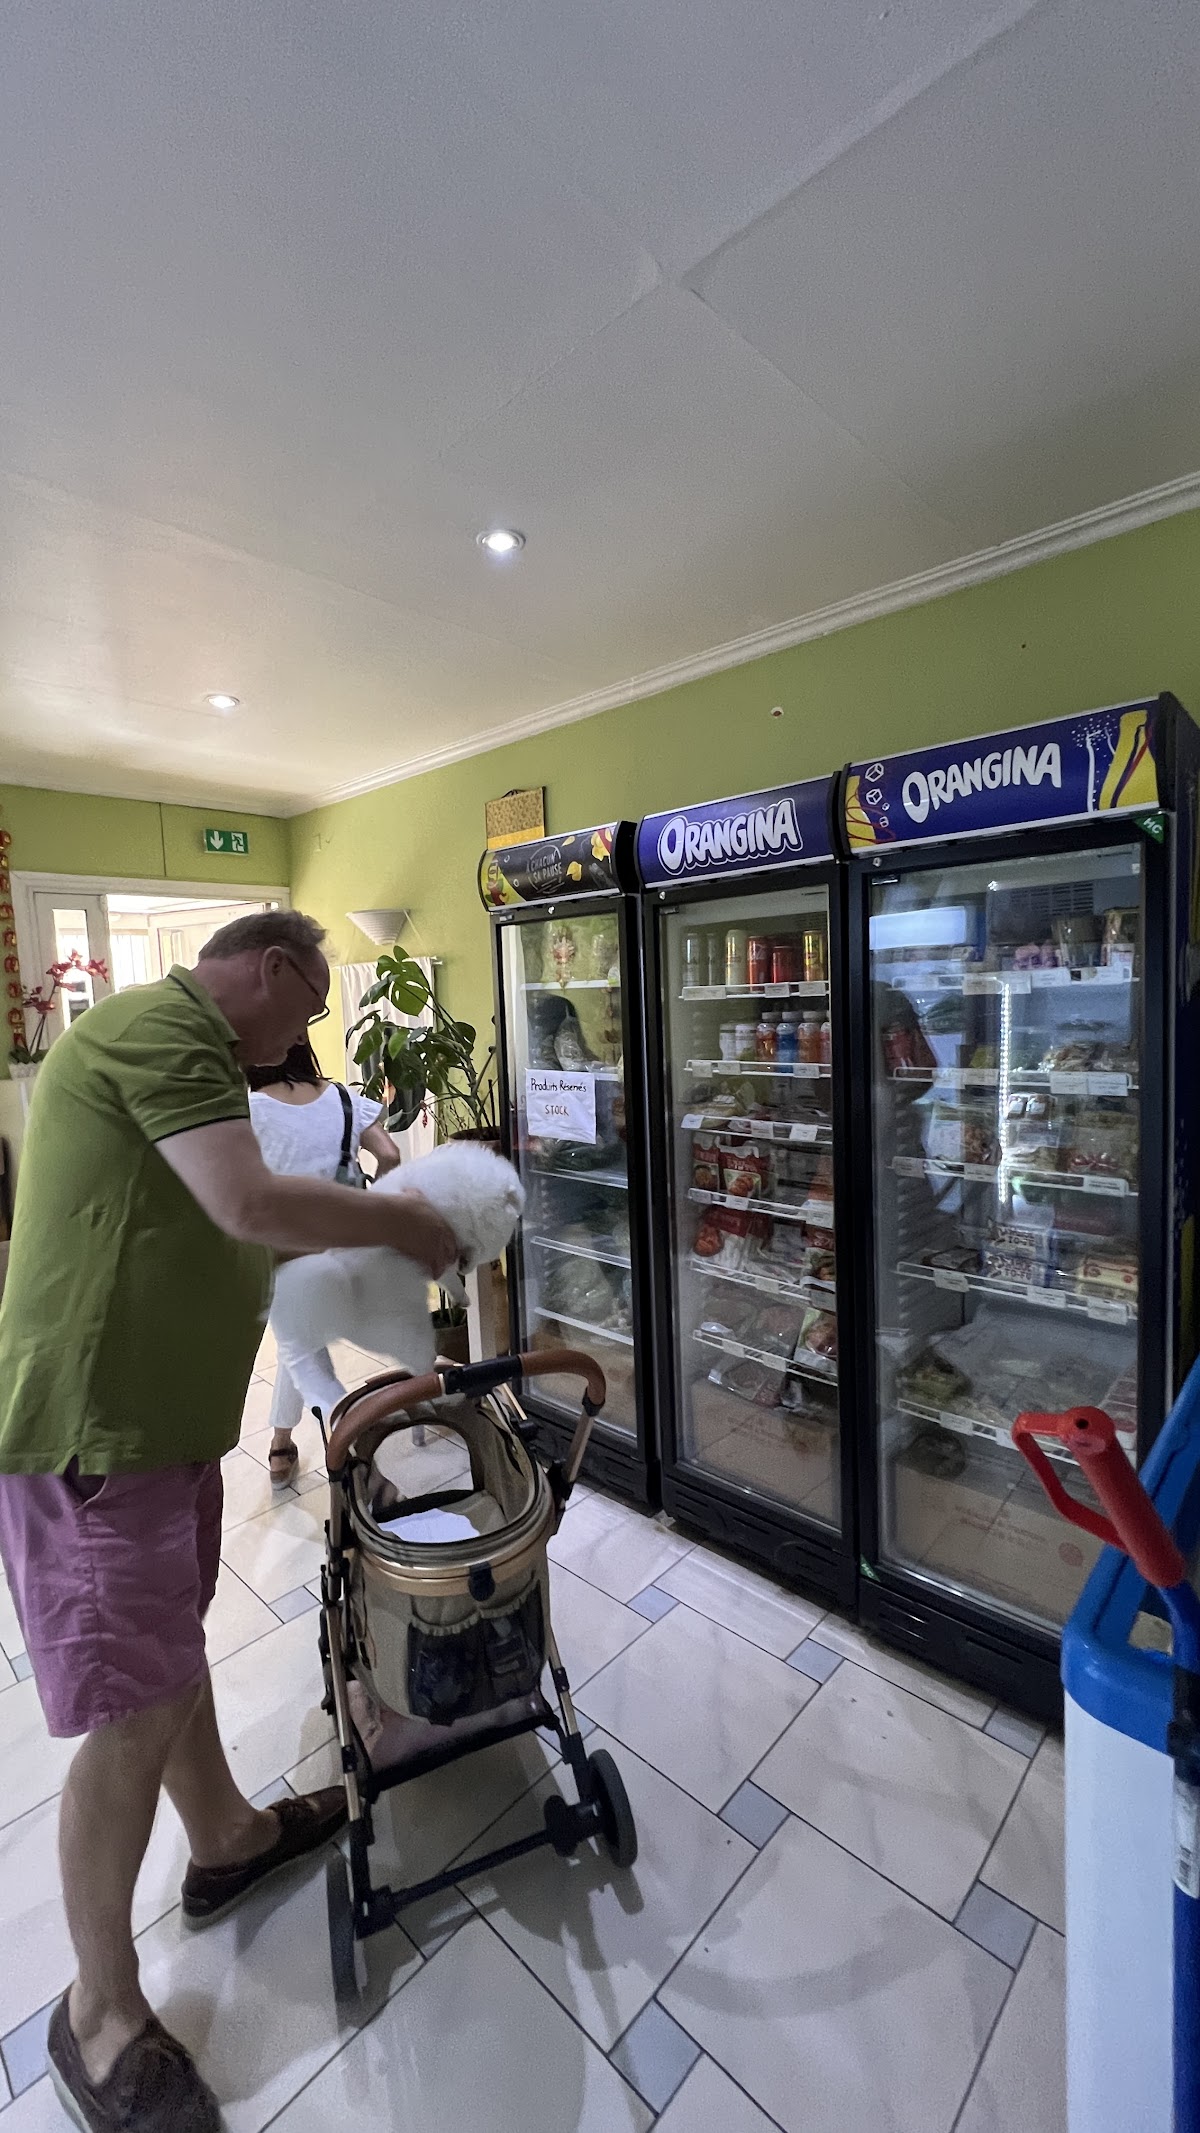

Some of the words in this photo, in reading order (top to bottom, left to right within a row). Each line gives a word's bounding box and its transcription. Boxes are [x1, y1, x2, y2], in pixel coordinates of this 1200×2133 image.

[902, 743, 1061, 824] ORANGINA
[658, 799, 801, 873] ORANGINA
[1143, 817, 1162, 834] HC
[531, 851, 557, 872] CHACUN
[533, 871, 542, 884] SA
[542, 862, 562, 879] PAUSE
[530, 1077, 558, 1091] Produits
[544, 1104, 569, 1116] STOCK
